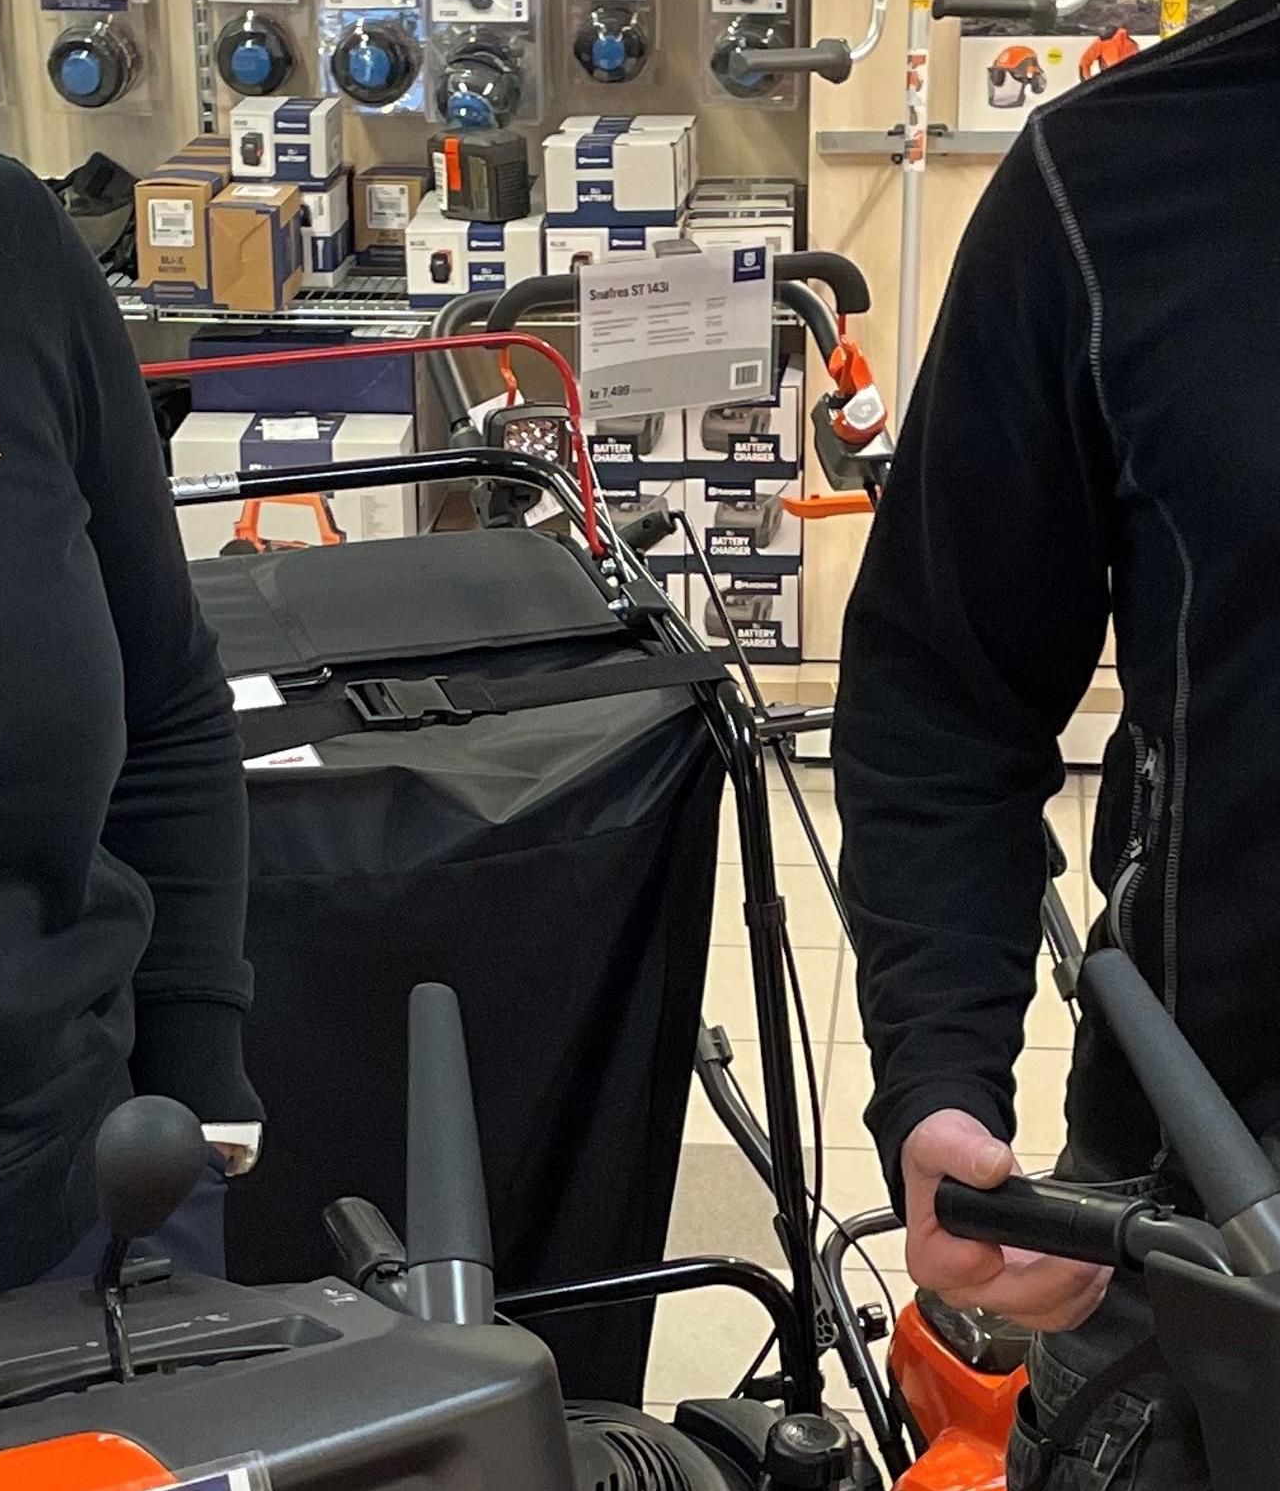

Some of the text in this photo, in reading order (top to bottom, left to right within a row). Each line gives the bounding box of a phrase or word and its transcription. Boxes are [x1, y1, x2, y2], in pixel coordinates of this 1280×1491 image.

[631, 283, 645, 297] ST
[592, 444, 632, 453] BATTERY
[734, 443, 774, 452] BATTERY
[592, 453, 634, 463] CHARGER
[734, 452, 775, 462] CHARGER
[711, 536, 750, 545] BATTERY
[710, 545, 751, 555] CHARGER
[737, 629, 776, 638] BATTERY
